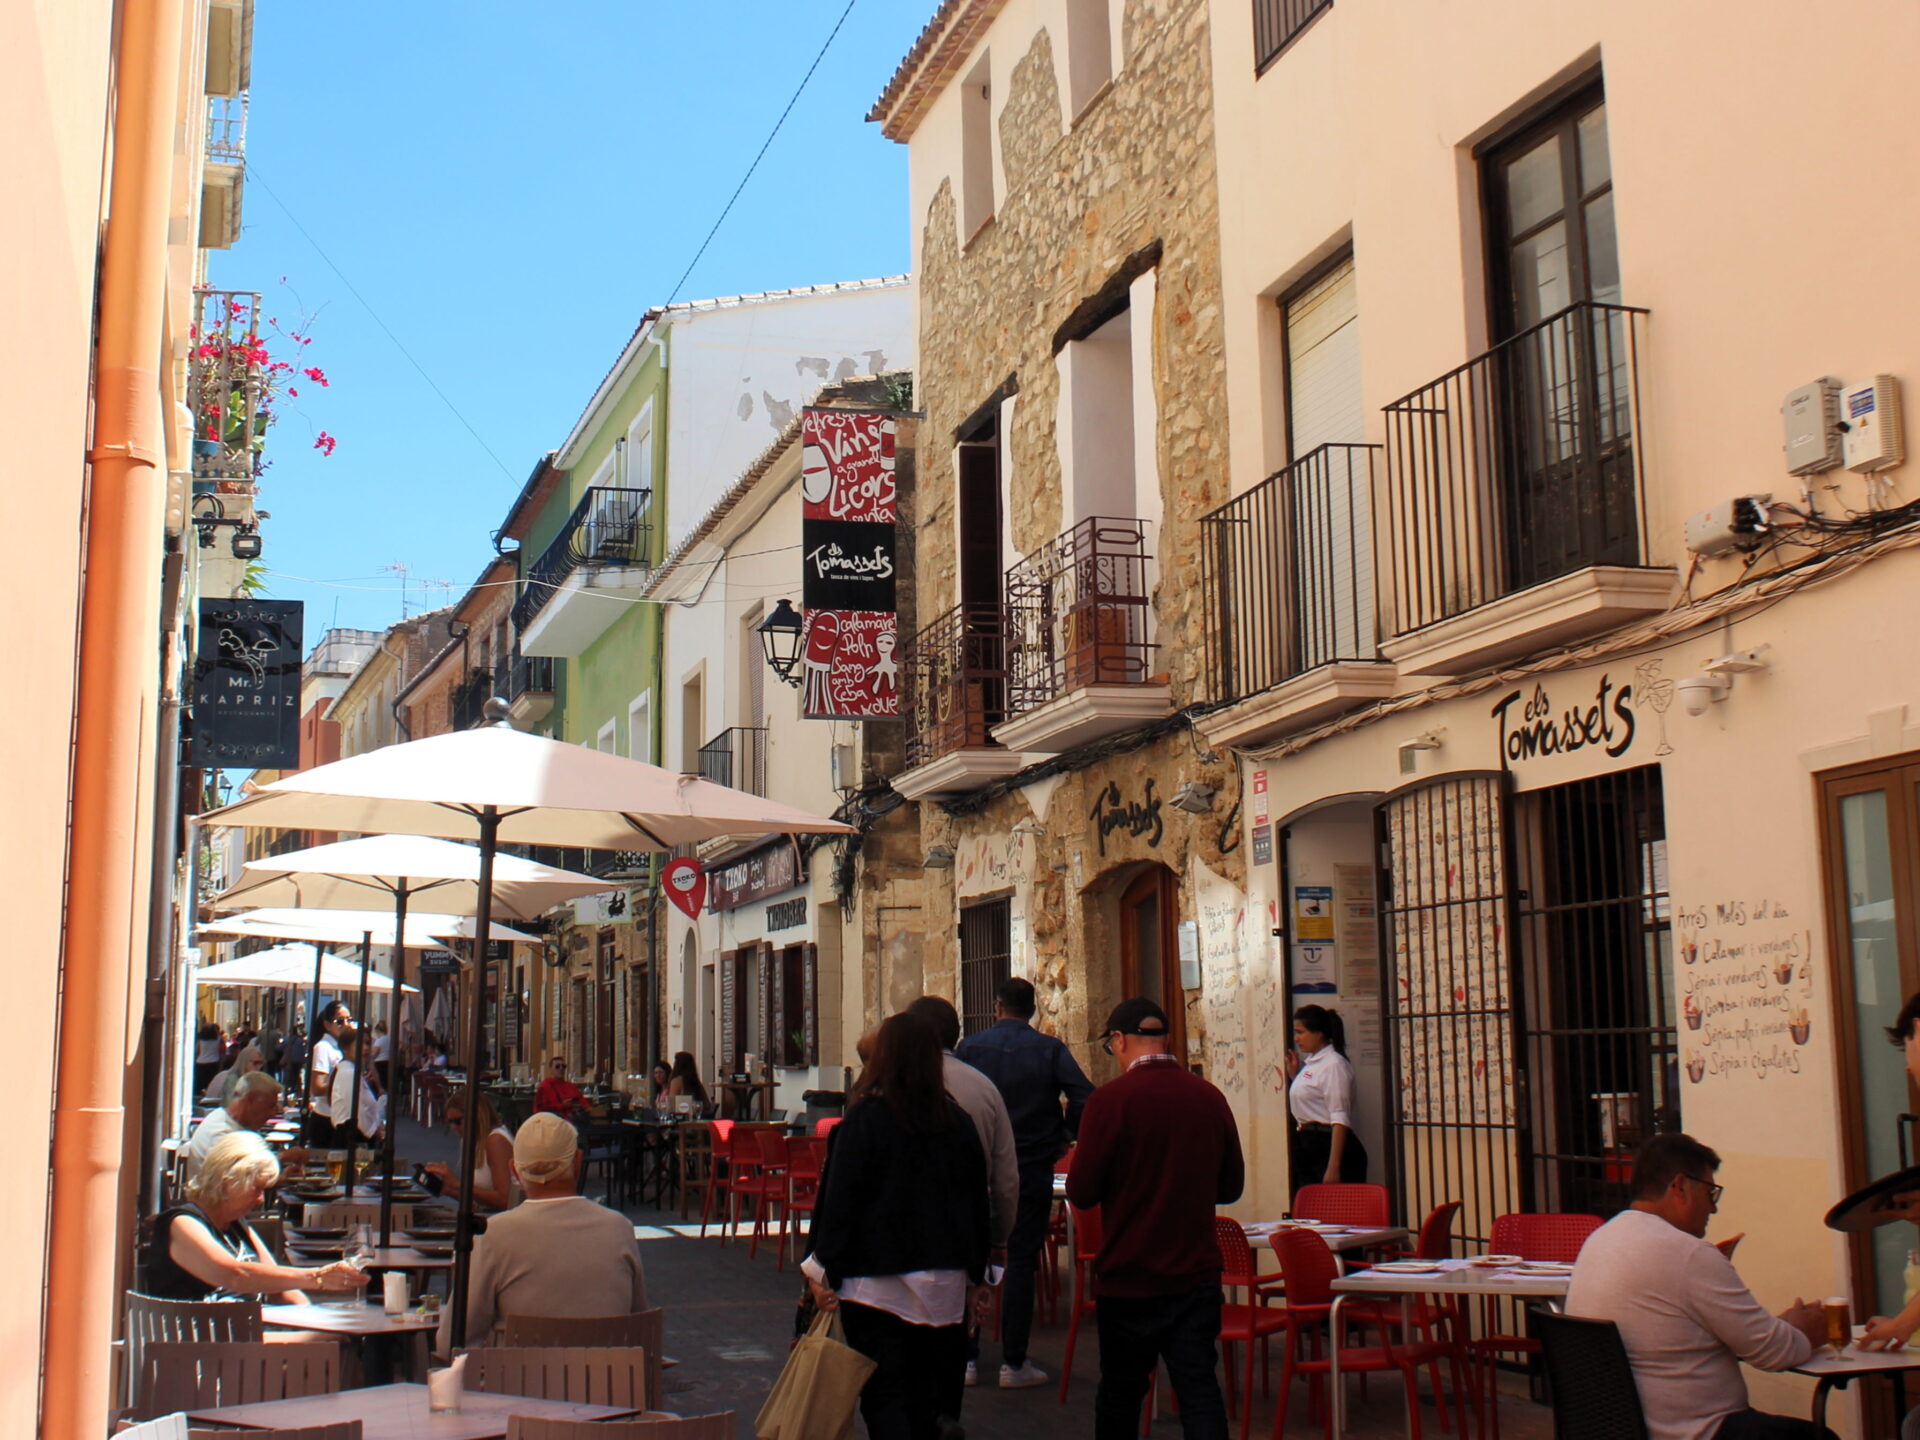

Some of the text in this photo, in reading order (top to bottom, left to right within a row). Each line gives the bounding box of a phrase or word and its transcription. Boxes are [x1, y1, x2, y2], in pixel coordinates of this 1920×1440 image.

[828, 543, 843, 556] els
[806, 545, 893, 579] Tomassets
[831, 657, 865, 682] Sang
[229, 677, 252, 688] Mr.
[200, 694, 294, 706] KAPRIZ
[1491, 673, 1635, 770] Tomassets
[672, 873, 696, 884] TXOKO
[725, 863, 748, 891] TXOKO
